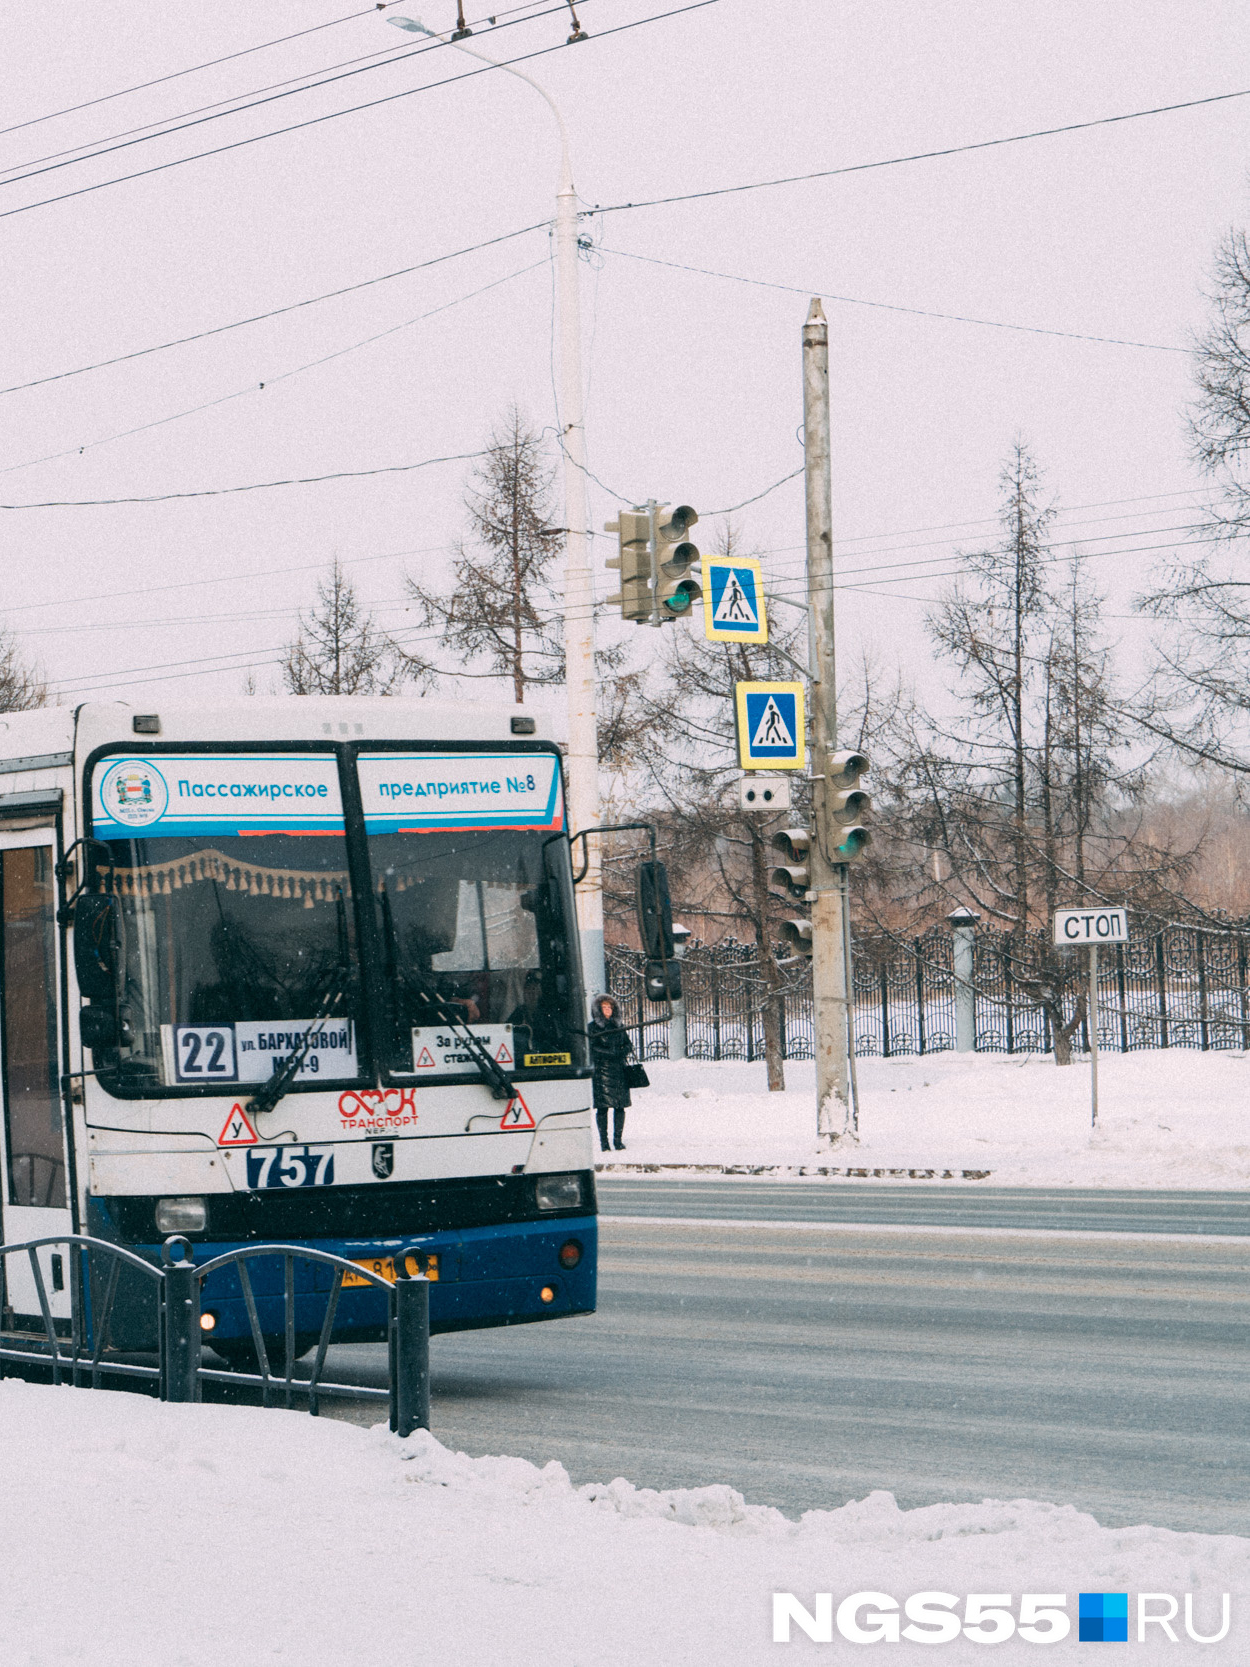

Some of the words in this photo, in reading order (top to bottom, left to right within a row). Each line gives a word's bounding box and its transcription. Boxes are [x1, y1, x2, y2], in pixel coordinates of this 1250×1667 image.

[178, 778, 329, 801] Пассажирское
[379, 776, 501, 799] предприятие
[506, 774, 536, 794] №8
[1064, 914, 1121, 939] СТОП
[241, 1039, 255, 1052] ул.
[258, 1028, 348, 1051] БАРХАТОВОЙ
[436, 1035, 451, 1047] За
[182, 1032, 226, 1073] 22
[340, 1115, 419, 1129] ТРАНСПОРТ
[249, 1147, 333, 1188] 757
